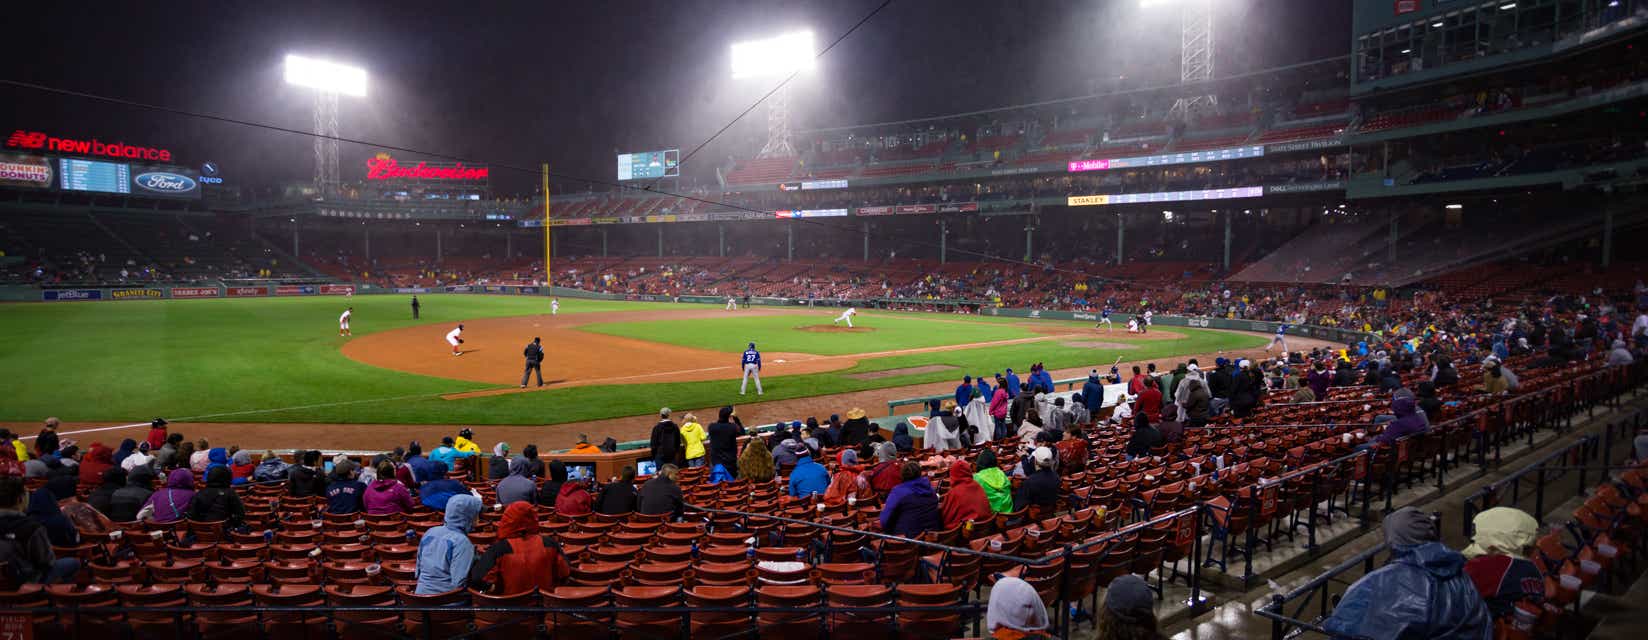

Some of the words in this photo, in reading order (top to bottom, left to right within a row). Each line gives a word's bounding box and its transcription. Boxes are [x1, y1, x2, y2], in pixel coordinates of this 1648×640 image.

[48, 137, 91, 154] new
[92, 139, 171, 161] balance
[0, 171, 46, 181] DONUTS
[367, 158, 489, 180] Budweiser
[147, 174, 185, 190] Ford
[1073, 196, 1104, 204] STANLEY
